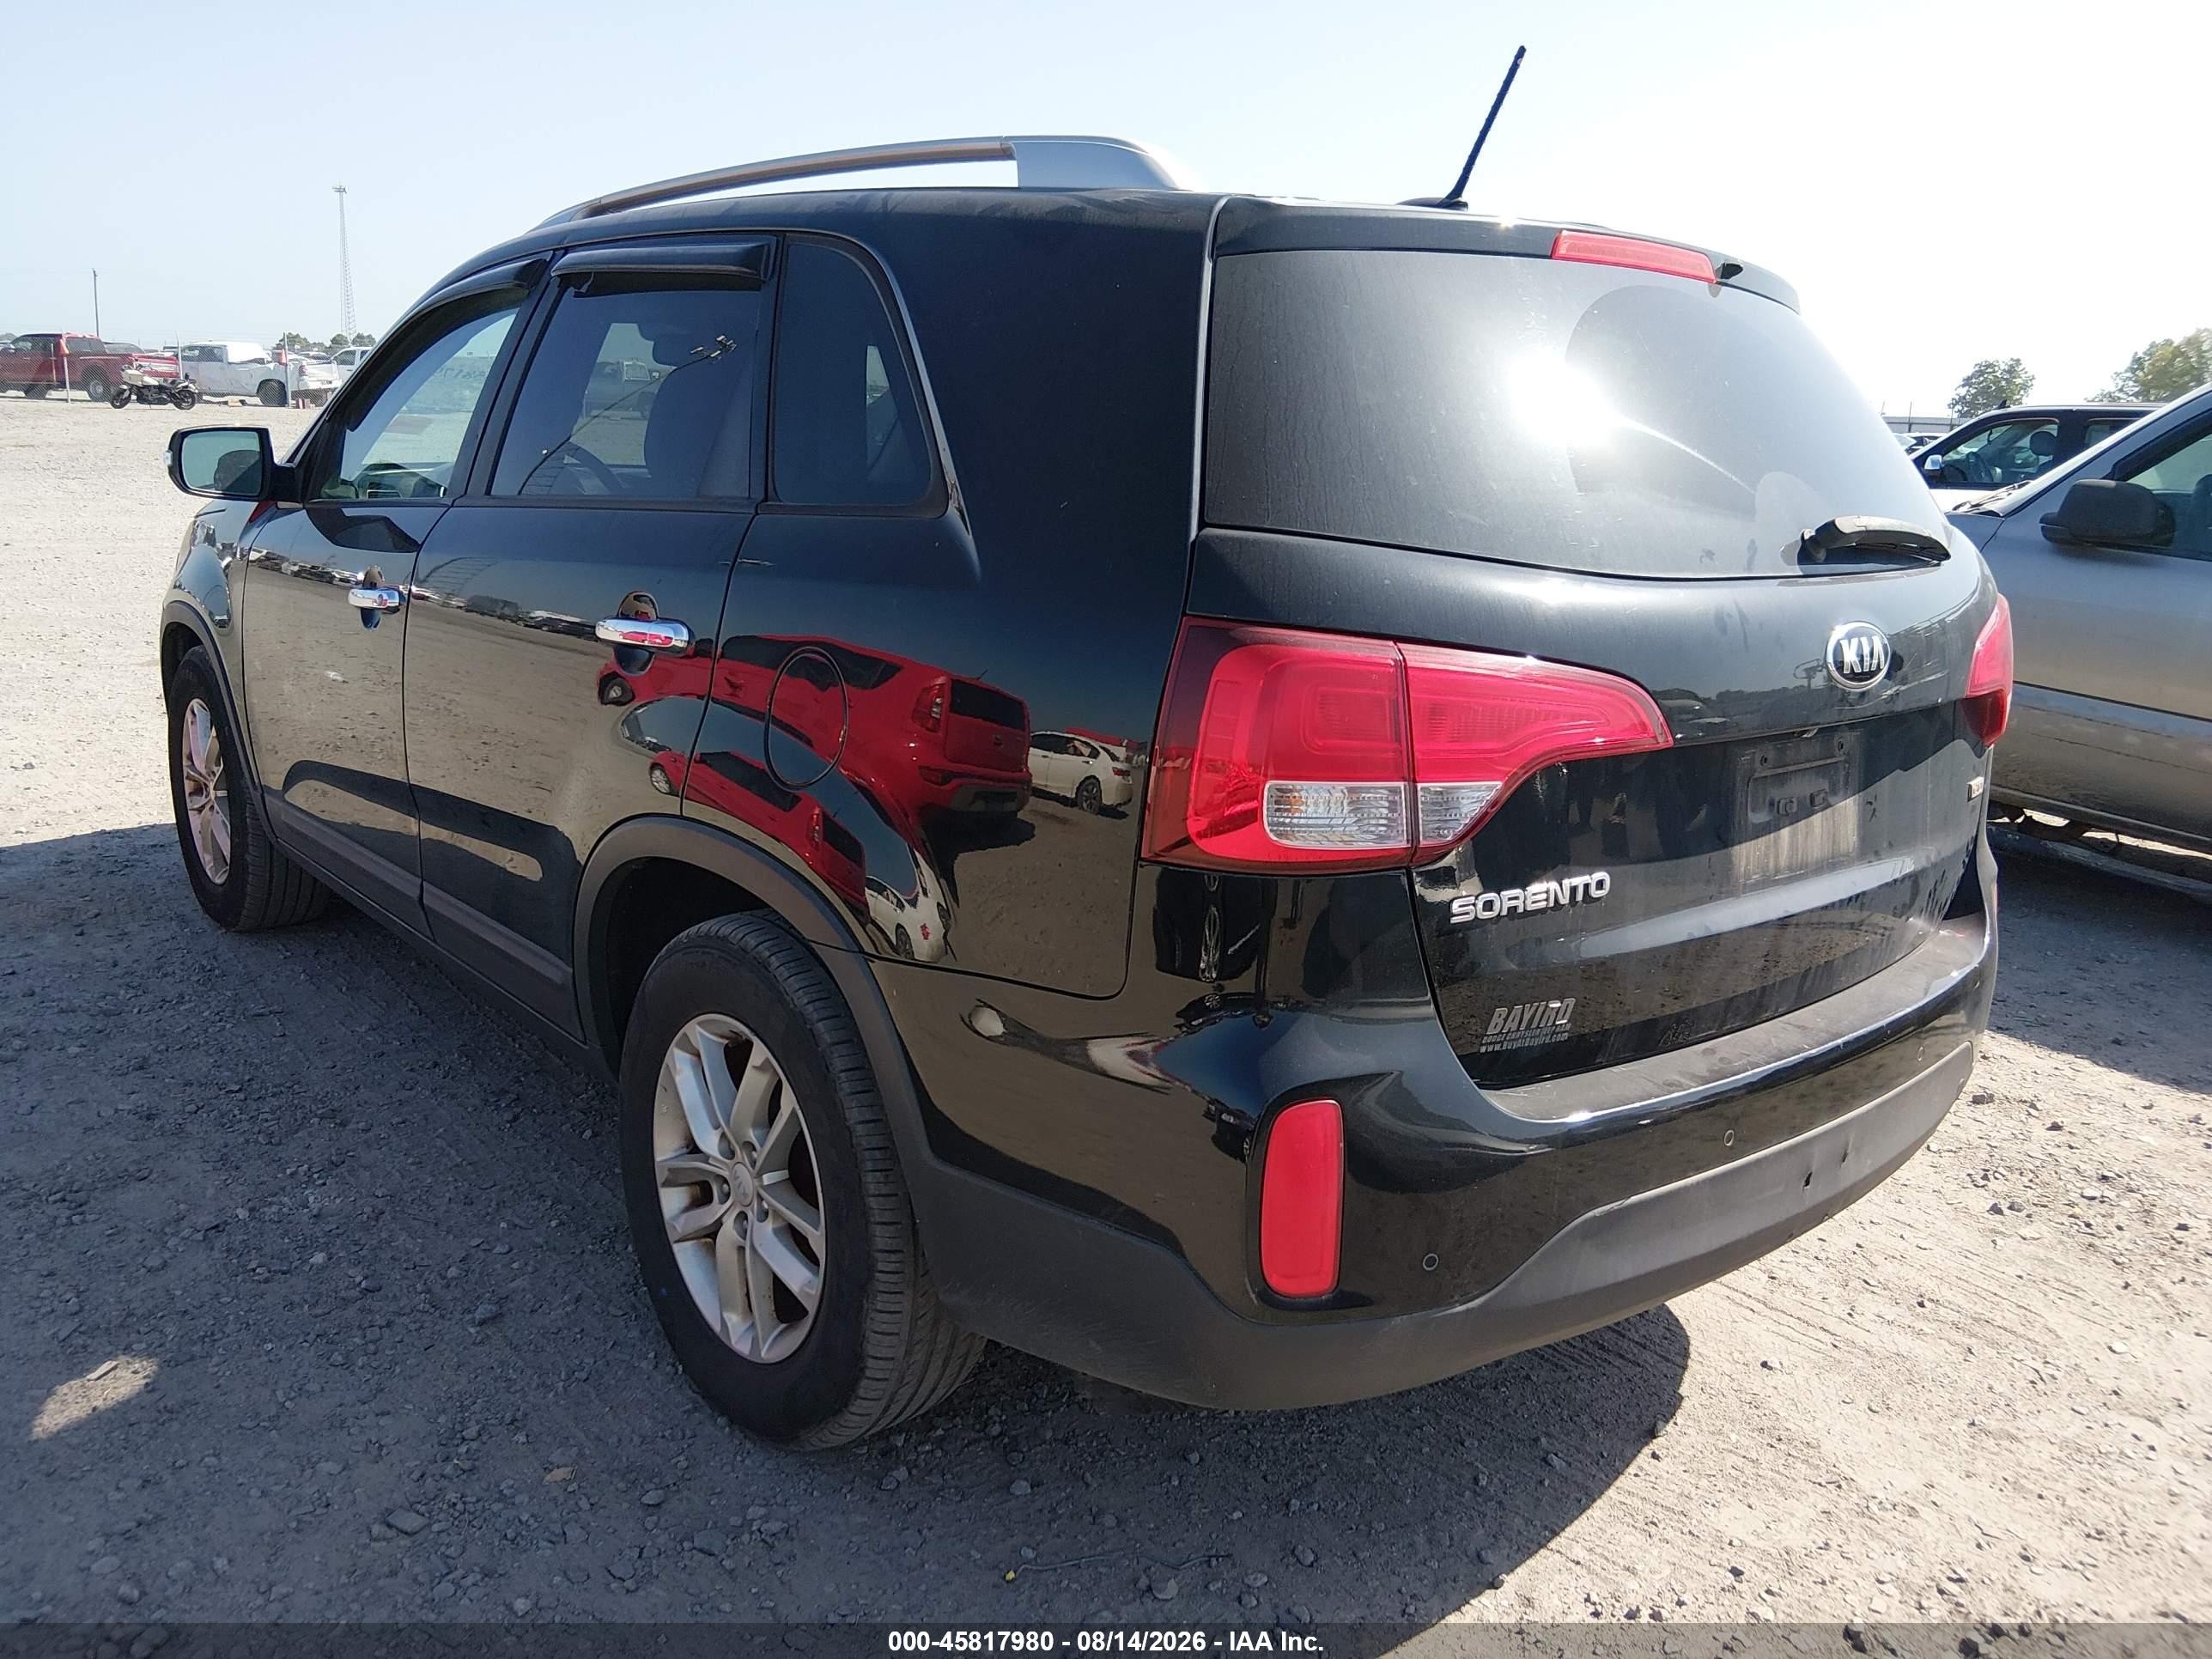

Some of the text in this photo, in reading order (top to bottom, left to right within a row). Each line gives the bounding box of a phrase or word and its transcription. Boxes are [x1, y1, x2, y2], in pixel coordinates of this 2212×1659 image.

[1839, 635, 1884, 674] KIA
[1450, 872, 1610, 924] SORENTO
[1486, 998, 1576, 1035] BAYIRD
